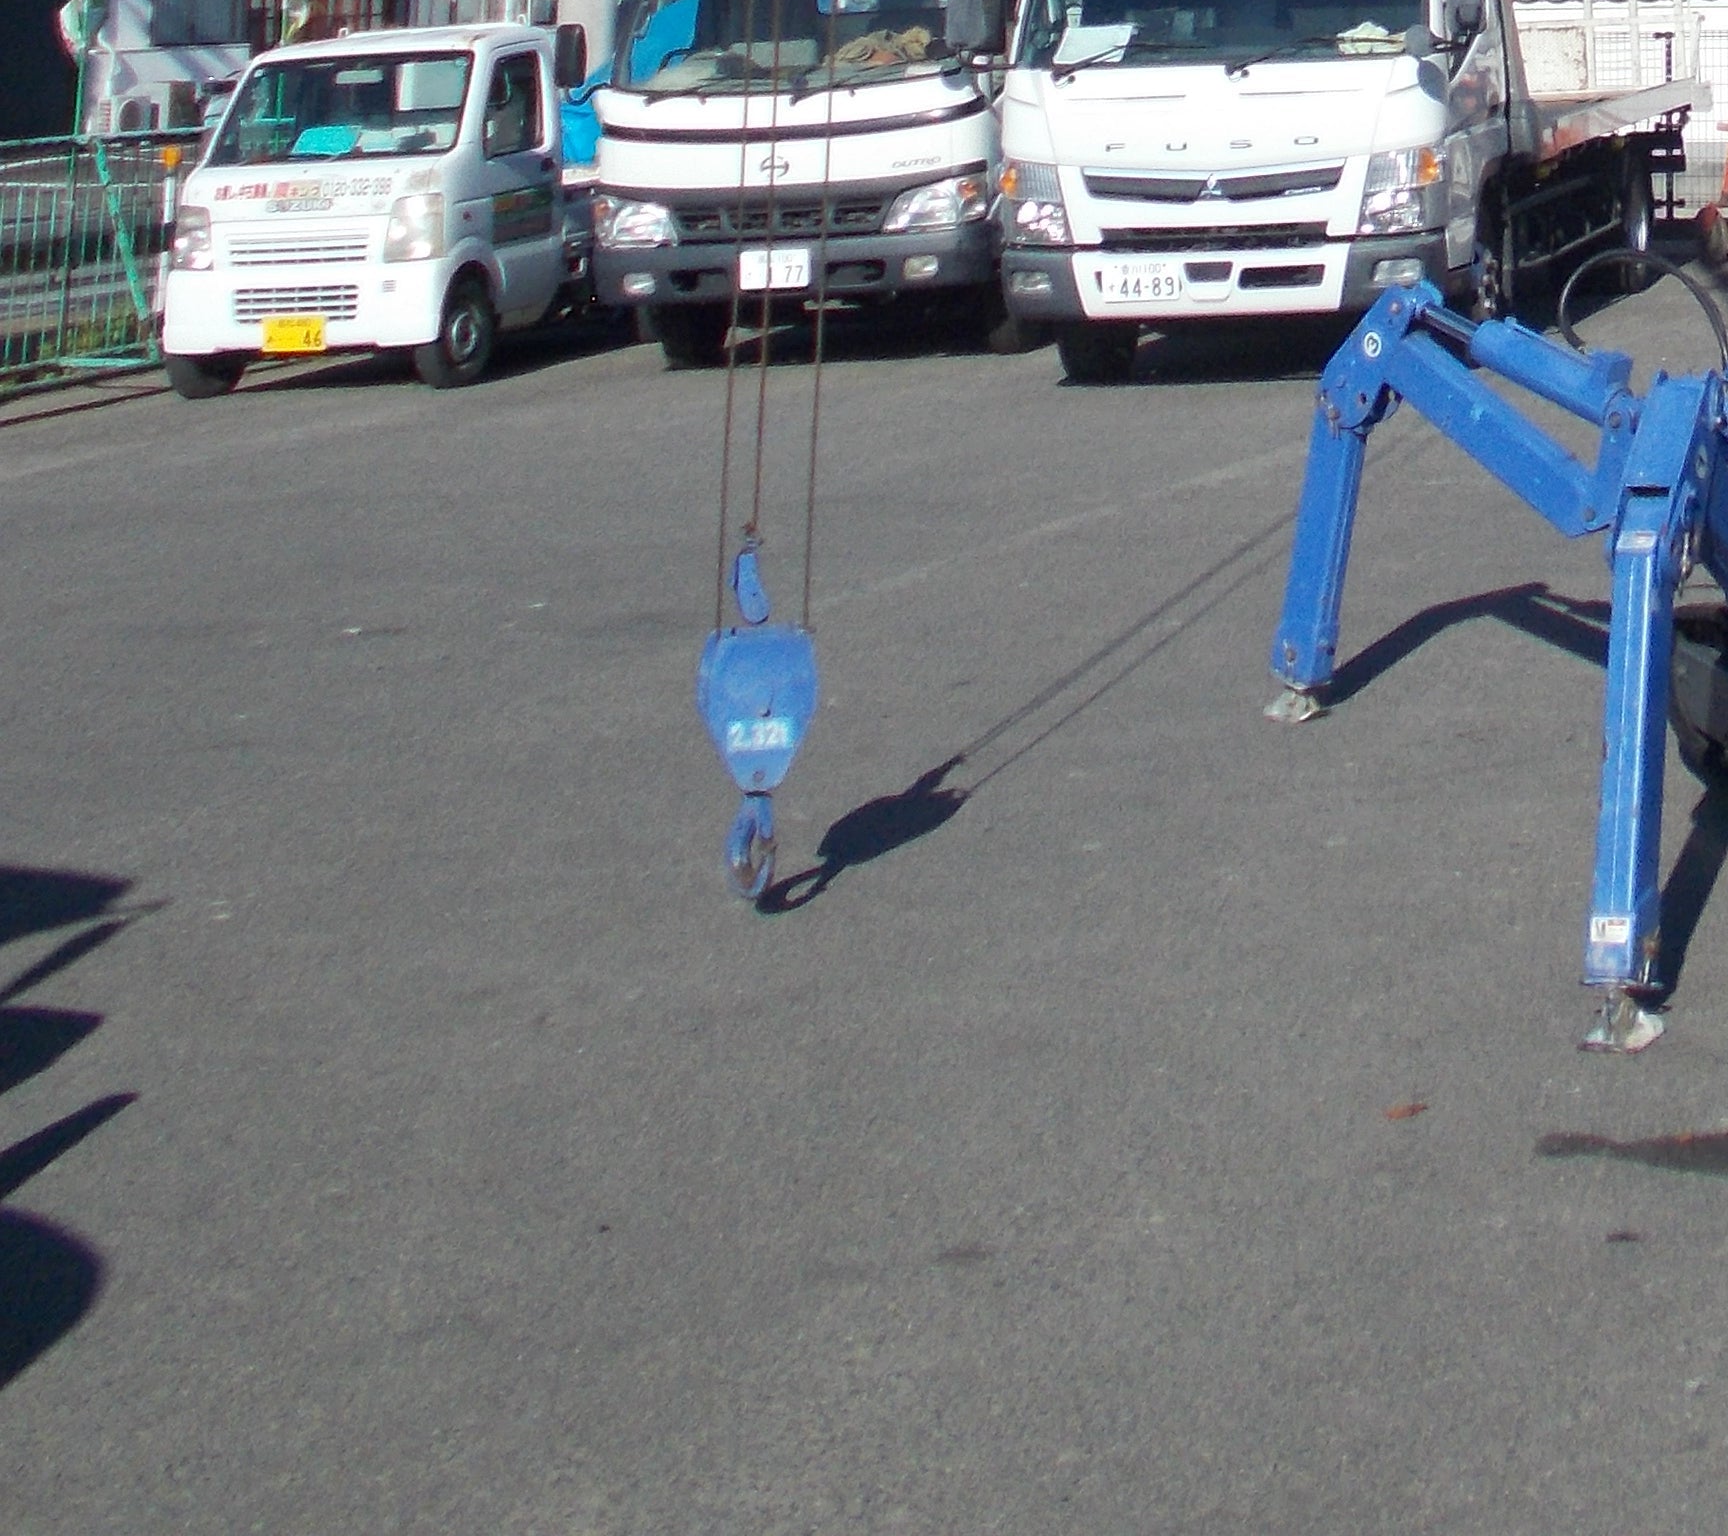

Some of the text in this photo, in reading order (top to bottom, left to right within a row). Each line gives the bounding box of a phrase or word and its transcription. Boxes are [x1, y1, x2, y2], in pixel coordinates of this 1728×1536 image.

[1105, 136, 1319, 152] FUSO
[265, 198, 333, 213] SUZUKI
[1120, 277, 1175, 297] 44-89
